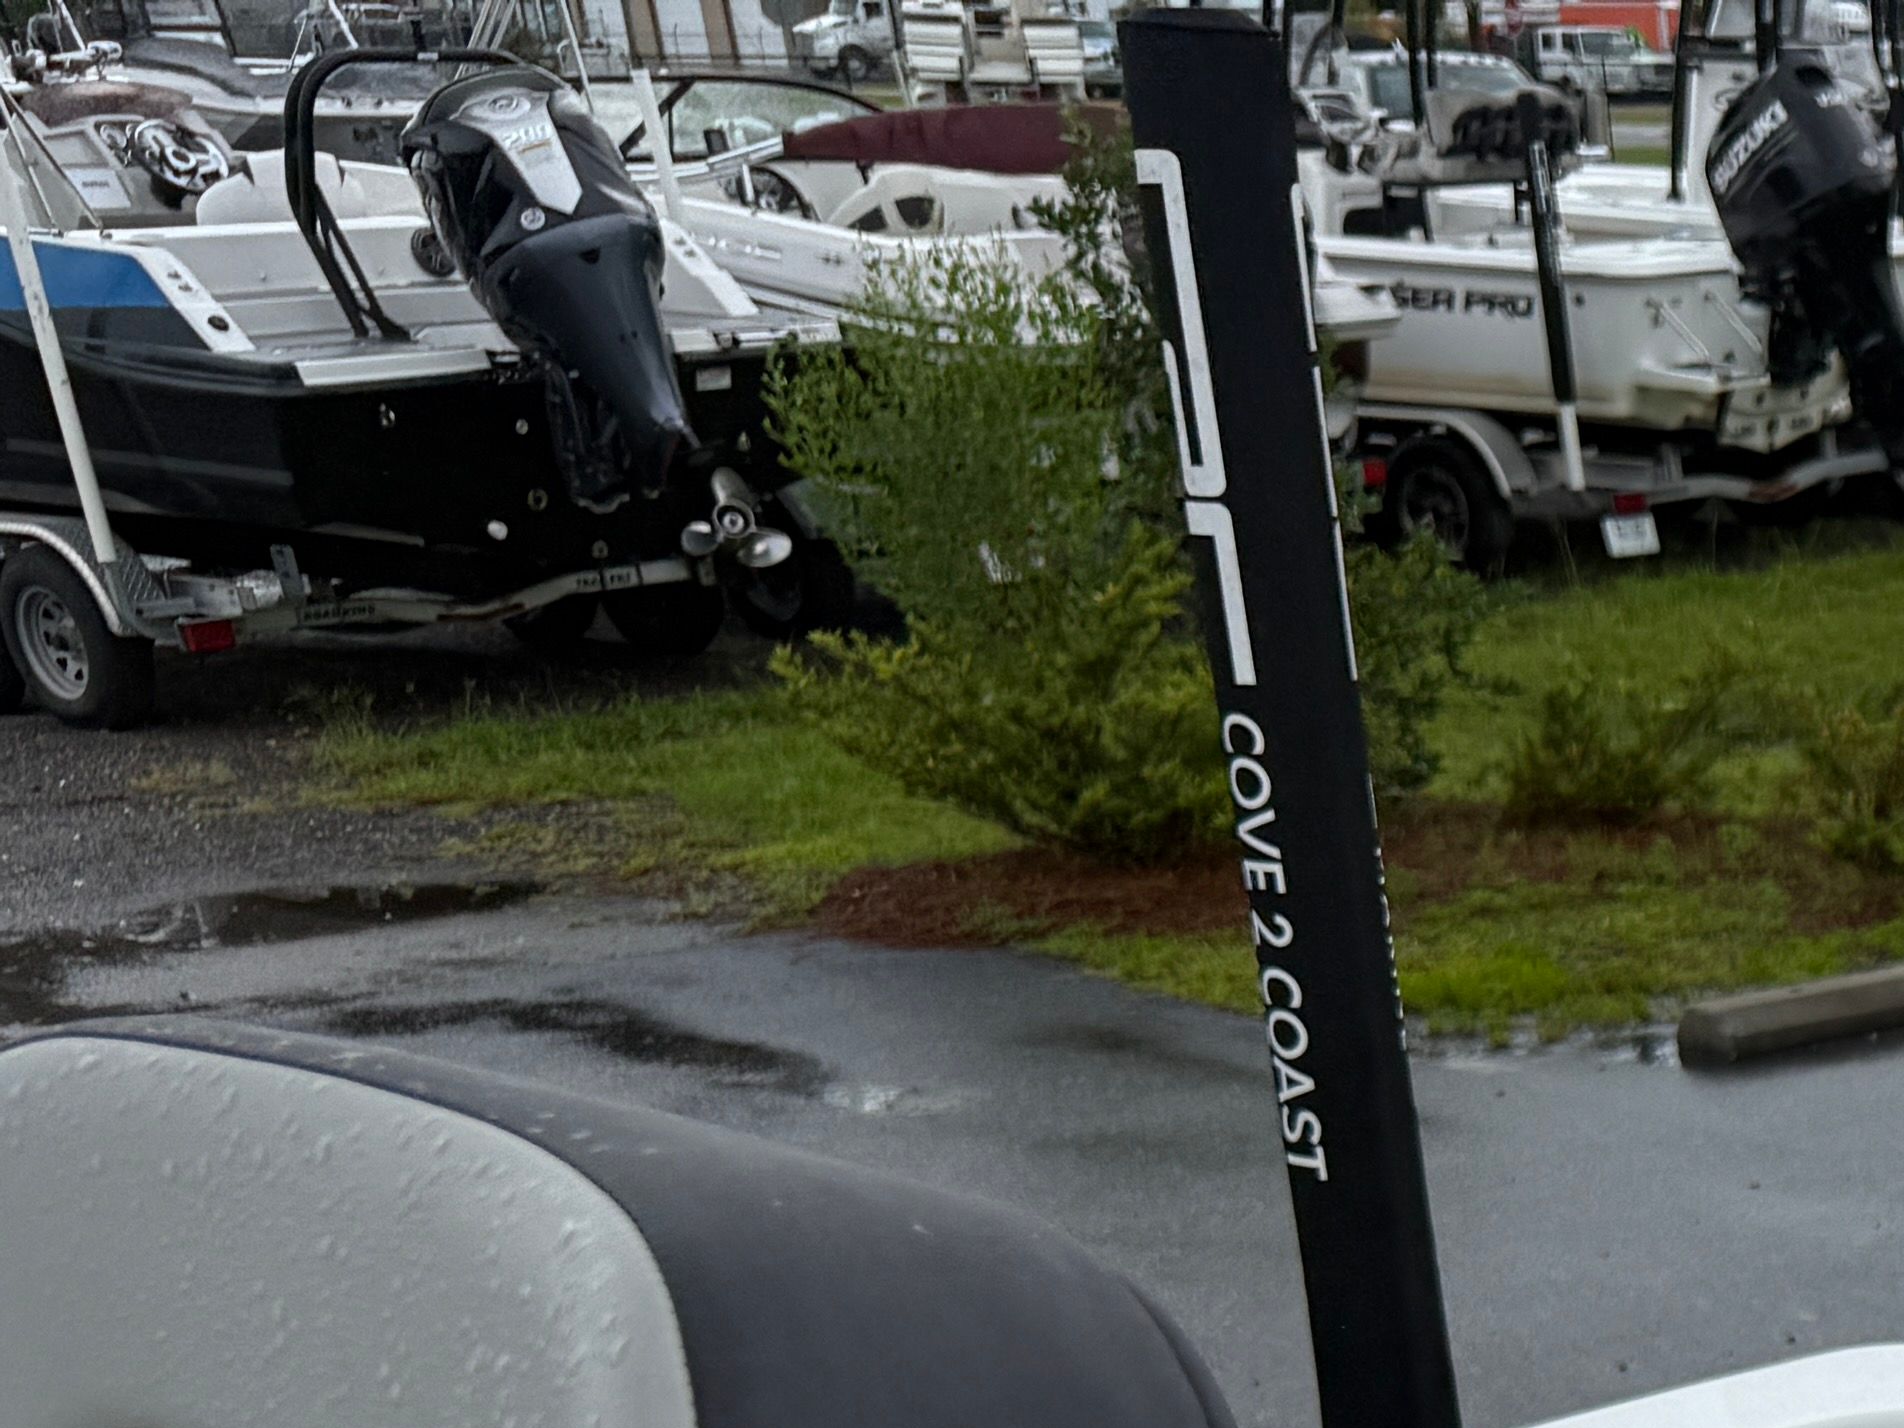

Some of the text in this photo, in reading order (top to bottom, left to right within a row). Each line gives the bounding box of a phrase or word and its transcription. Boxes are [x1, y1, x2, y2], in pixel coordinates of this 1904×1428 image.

[1712, 99, 1788, 195] SUZUKI
[1463, 289, 1535, 318] PRO
[1221, 712, 1329, 1182] COVE 2 COAST
